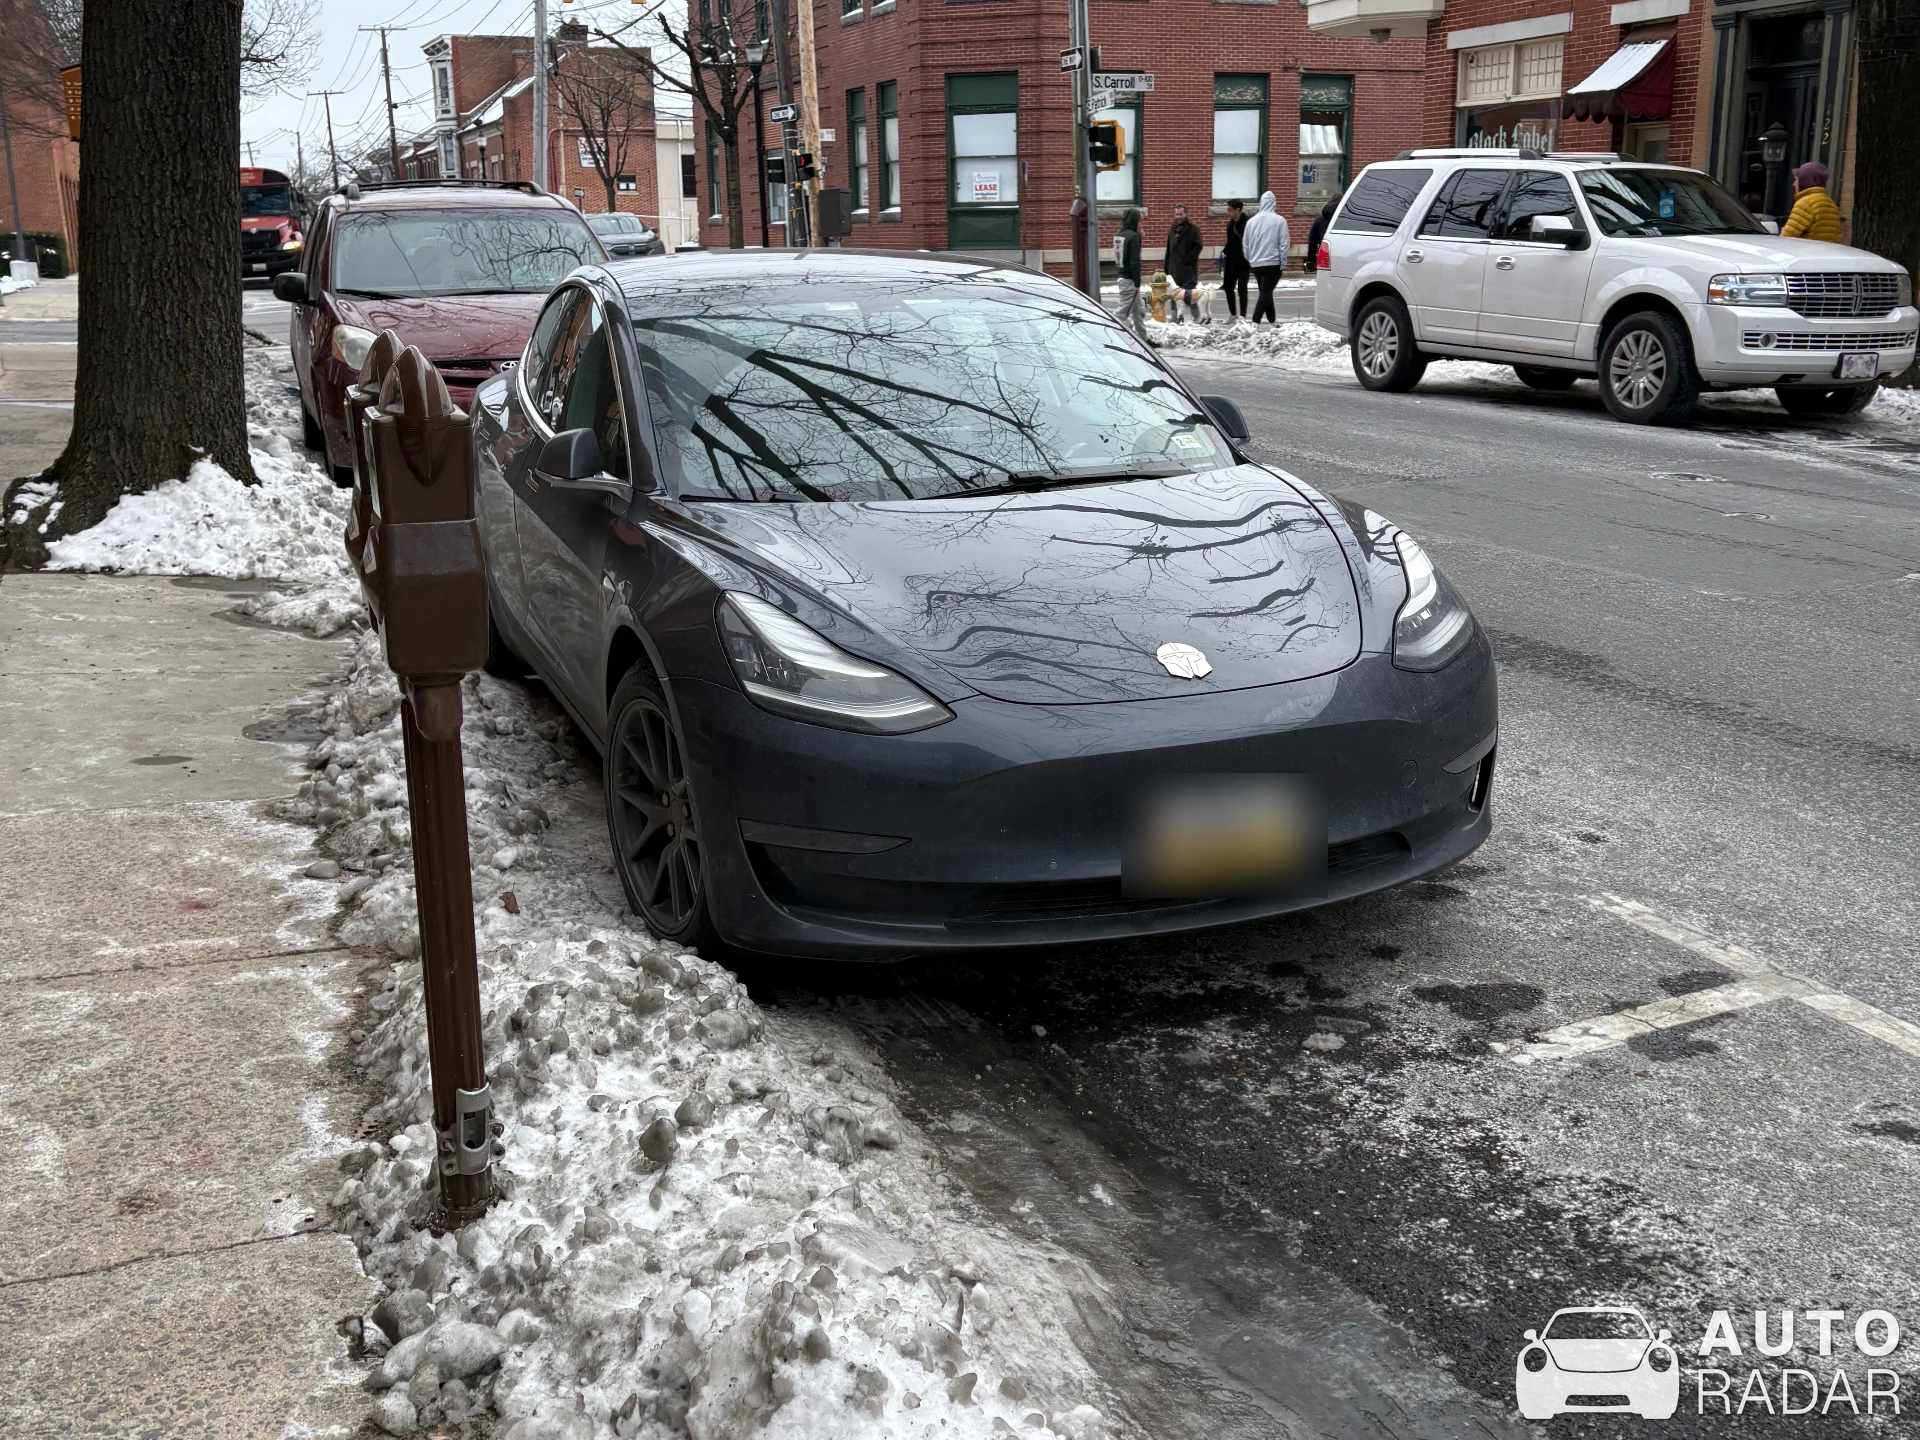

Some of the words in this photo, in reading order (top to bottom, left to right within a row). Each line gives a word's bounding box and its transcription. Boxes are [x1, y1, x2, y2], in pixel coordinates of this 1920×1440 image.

[1094, 75, 1103, 88] S.
[1104, 75, 1135, 88] Carroll
[1468, 125, 1507, 148] Black
[1511, 122, 1554, 152] Label
